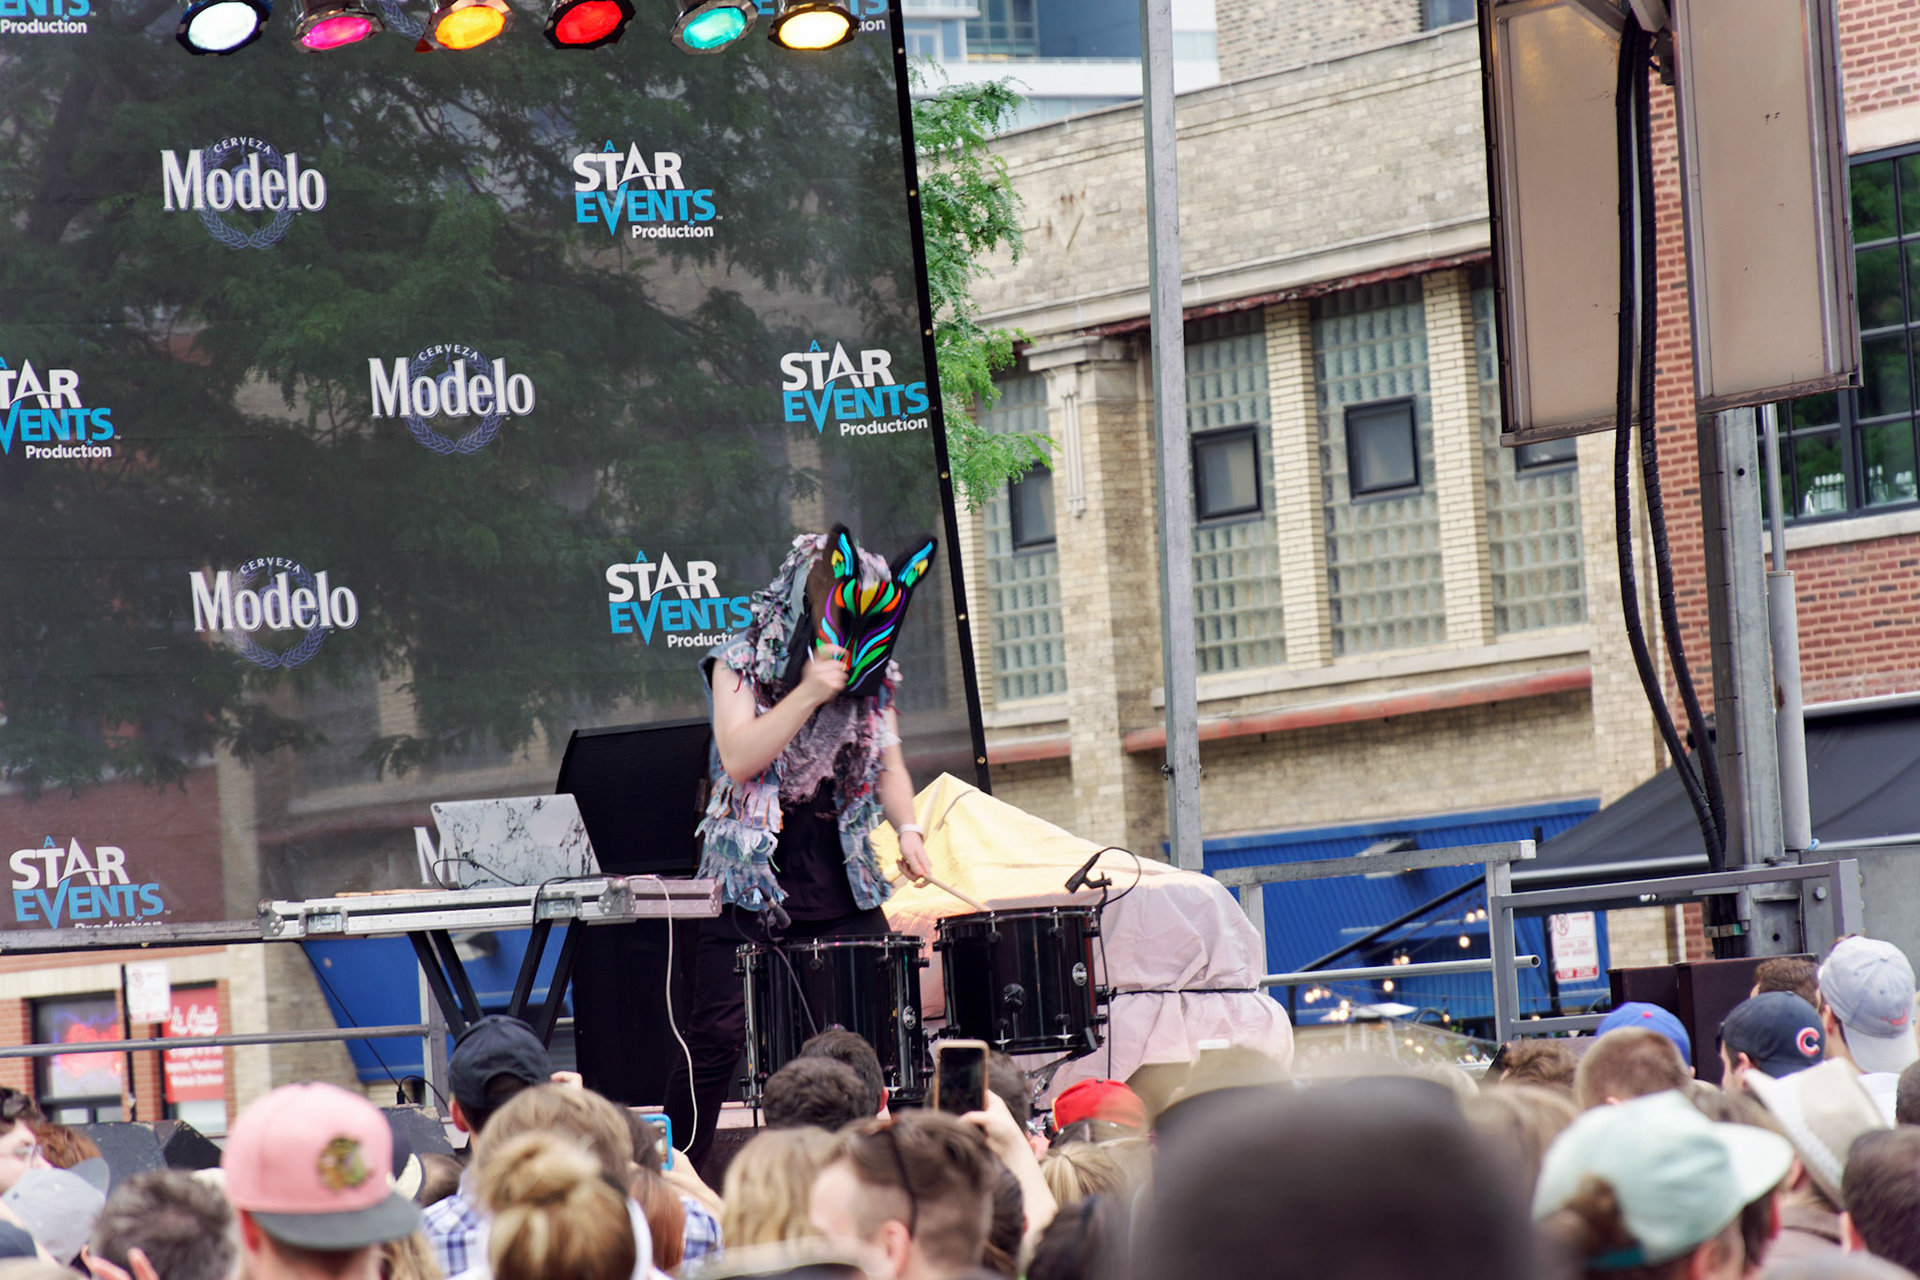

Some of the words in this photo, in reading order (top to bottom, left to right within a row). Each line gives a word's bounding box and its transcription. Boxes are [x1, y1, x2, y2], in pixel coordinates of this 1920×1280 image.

[0, 18, 88, 34] Production
[213, 136, 271, 154] CERVEZA
[572, 141, 686, 192] STAR
[603, 139, 616, 153] A
[160, 149, 327, 212] Modelo
[574, 181, 717, 236] EVENTS
[631, 224, 714, 239] Production
[418, 343, 479, 361] CERVEZA
[780, 341, 896, 391] STAR
[809, 339, 821, 352] A
[0, 358, 83, 410] TAR
[367, 356, 535, 418] Modelo
[782, 380, 930, 435] EVENTS
[0, 400, 115, 456] VENTS
[25, 444, 112, 459] Production
[839, 417, 928, 437] Production
[239, 556, 301, 574] CERVEZA
[605, 551, 721, 603] STAR
[635, 549, 648, 563] A
[189, 570, 359, 631] Modelo
[608, 591, 753, 646] EVENTS
[9, 836, 131, 890] STAR
[43, 834, 56, 849] A
[12, 877, 165, 930] EVENTS
